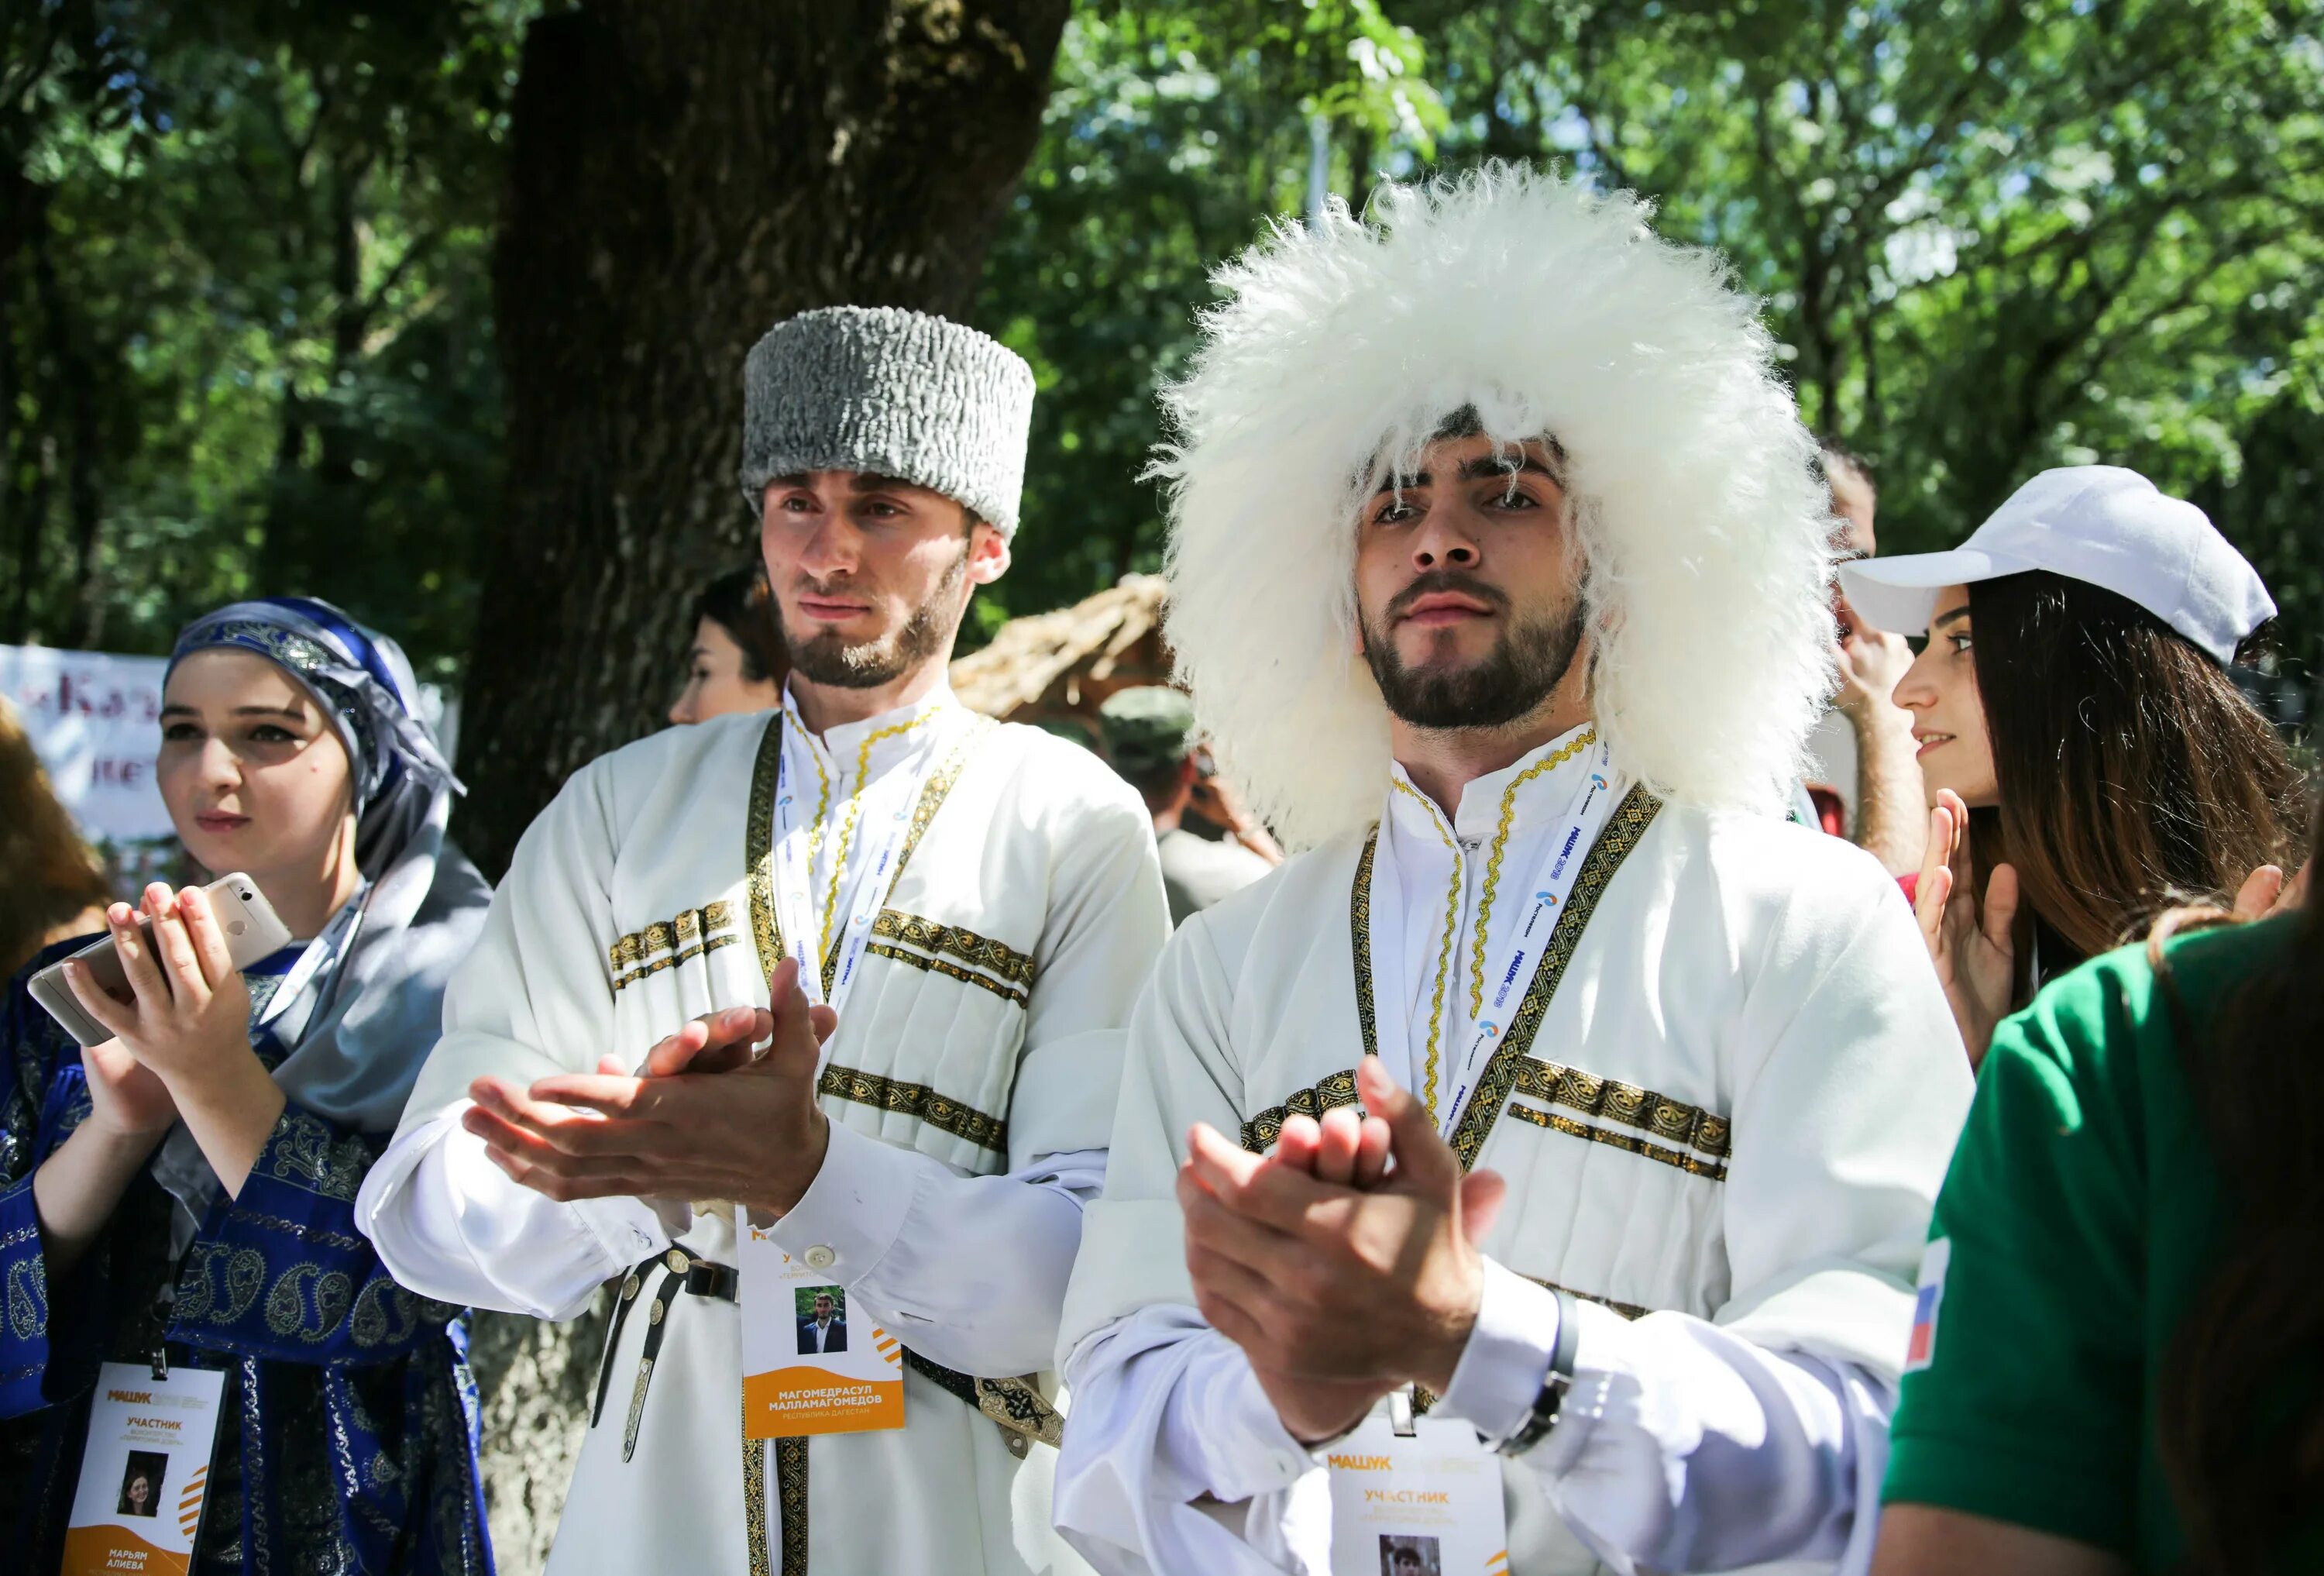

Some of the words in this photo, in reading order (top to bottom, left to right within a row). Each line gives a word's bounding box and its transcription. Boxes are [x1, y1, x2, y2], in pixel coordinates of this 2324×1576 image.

[1560, 826, 1581, 860] МАШУК
[1551, 858, 1566, 880] 2018
[1525, 903, 1543, 938] Ростелеком
[1504, 950, 1525, 986] МАШУК
[1494, 984, 1510, 1009] 2018
[107, 1389, 152, 1404] МАШУК
[779, 1385, 871, 1400] МАГОМЕДРАСУЛ
[769, 1395, 882, 1411] МАЛЛАМАГОМЕДОВ
[782, 1410, 830, 1419] РЕСПУБЛИКА
[831, 1408, 870, 1417] ДАГЕСТАН
[126, 1416, 183, 1430] УЧАСТНИК
[1328, 1454, 1392, 1470] МАШУК
[1364, 1489, 1450, 1504] УЧАСТНИК
[108, 1549, 148, 1561] МАРЬЯМ
[106, 1559, 144, 1571] АЛИЕВА
